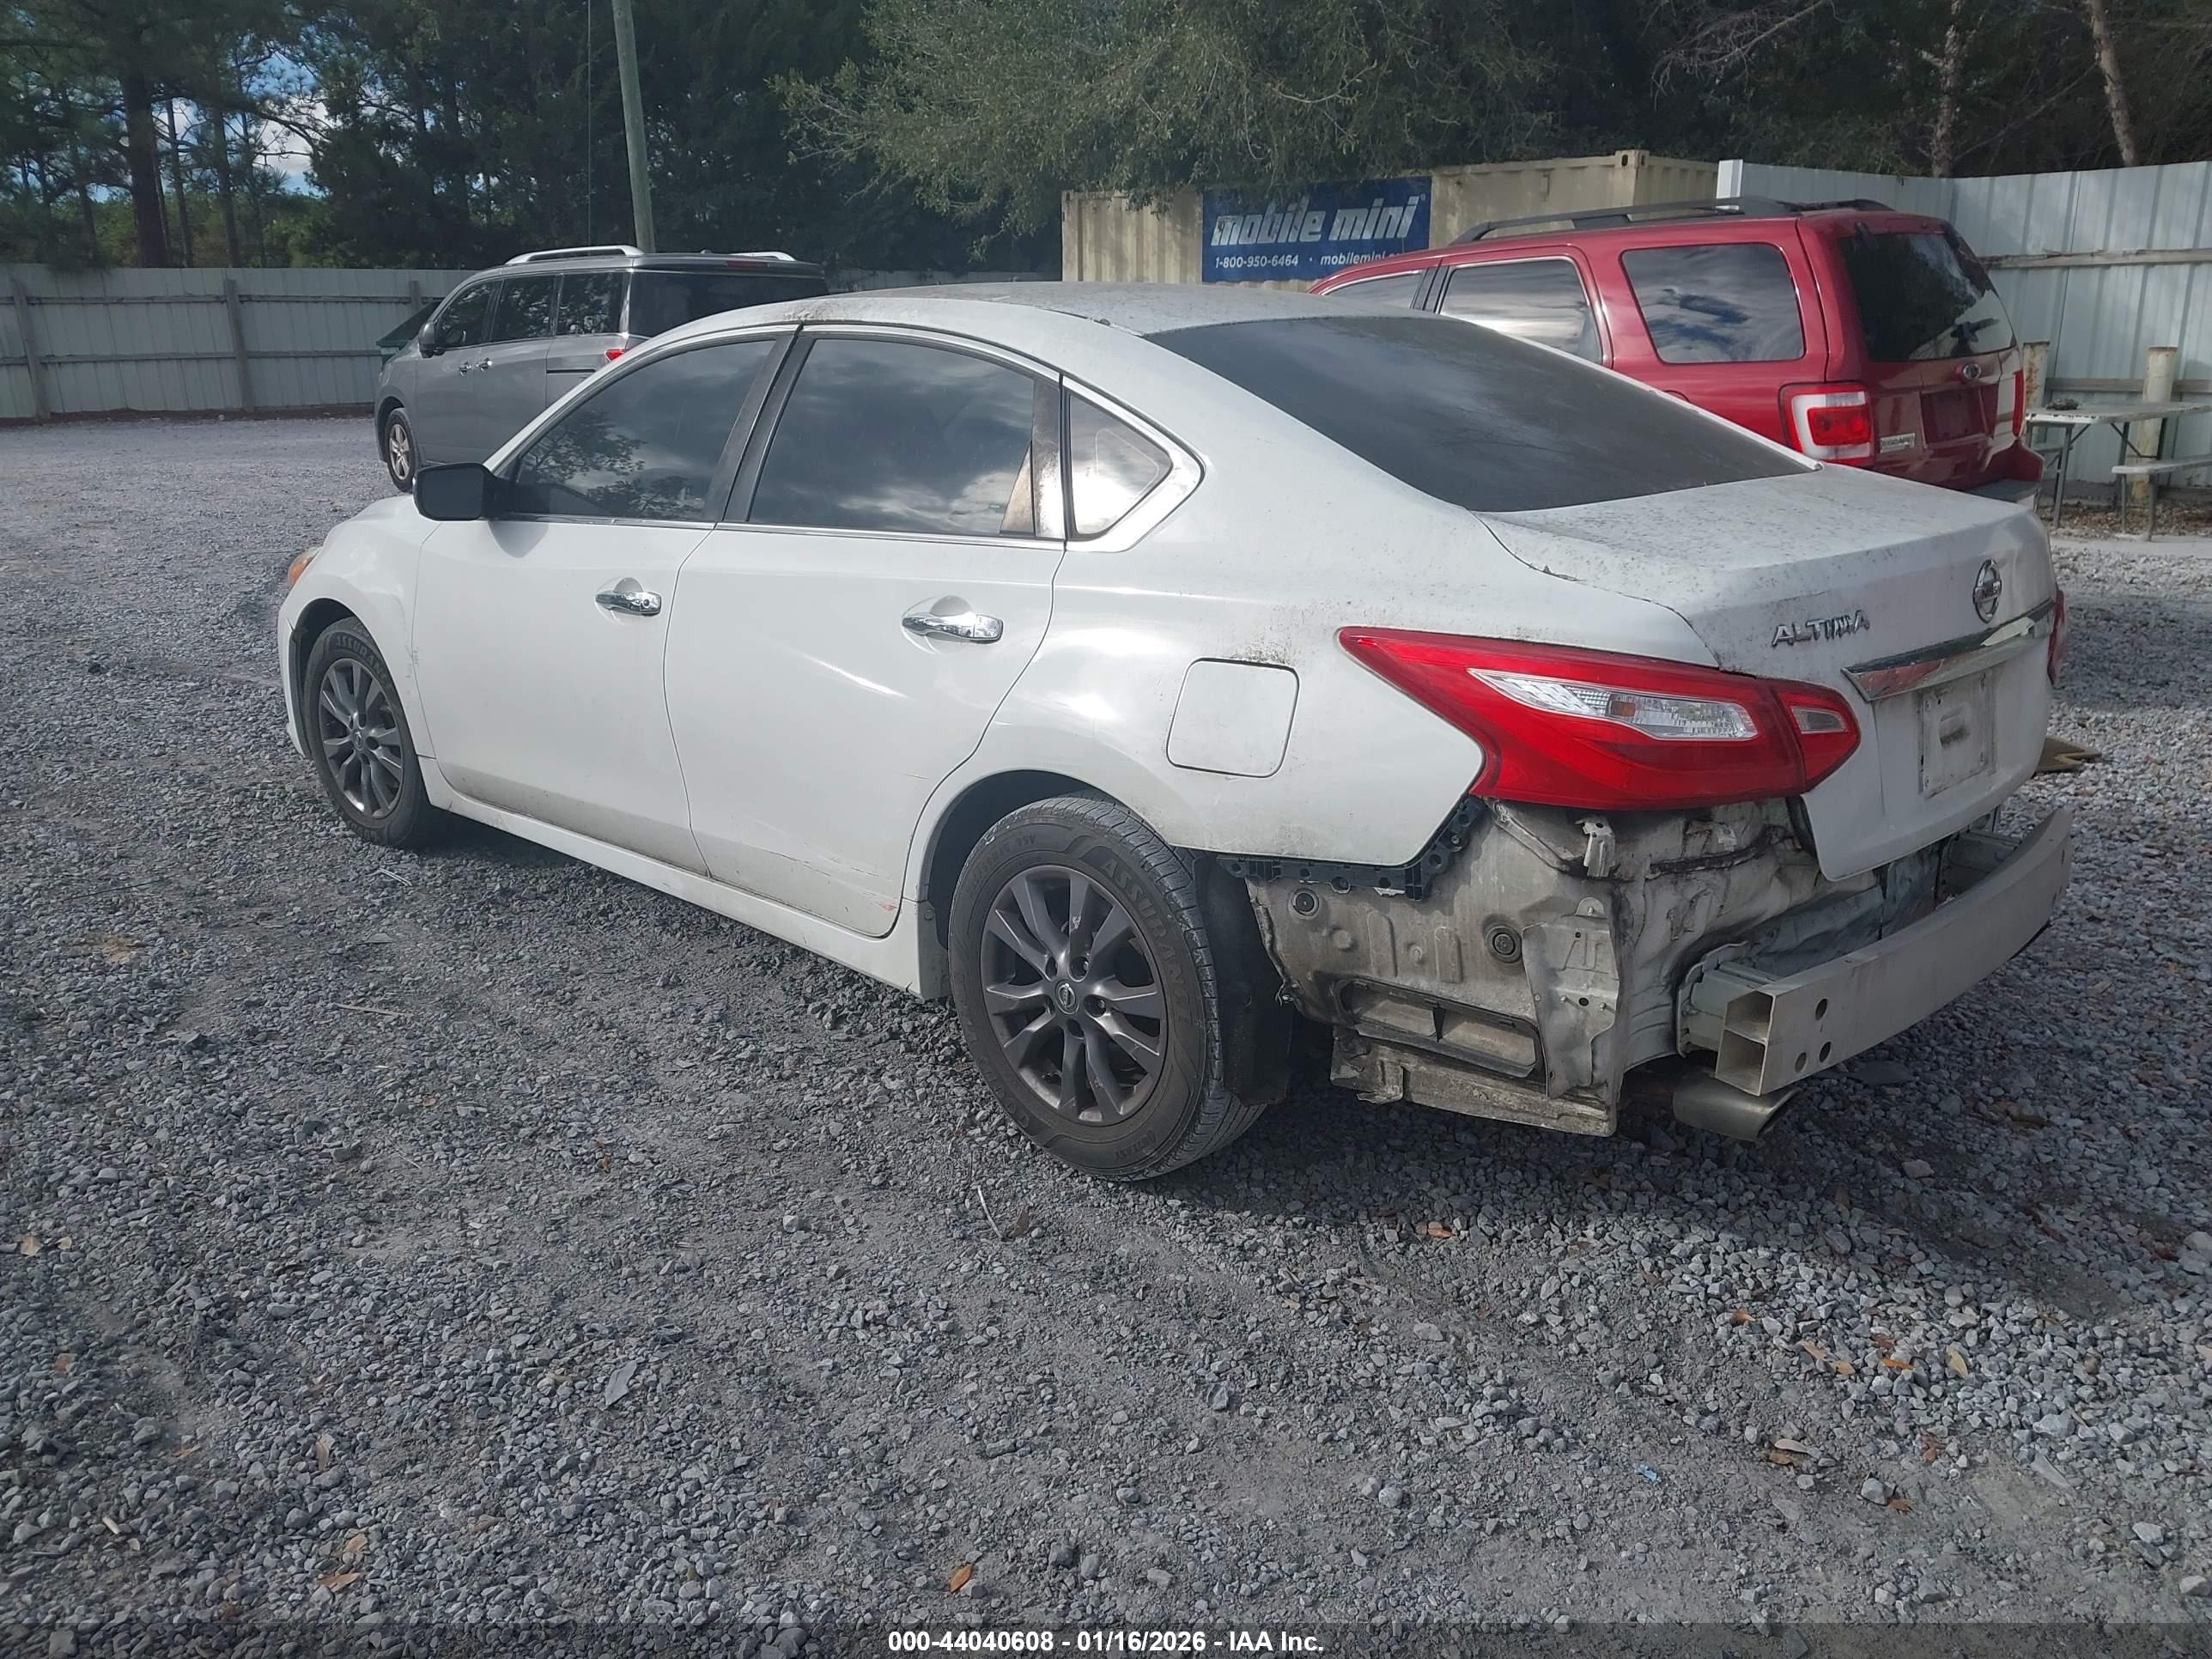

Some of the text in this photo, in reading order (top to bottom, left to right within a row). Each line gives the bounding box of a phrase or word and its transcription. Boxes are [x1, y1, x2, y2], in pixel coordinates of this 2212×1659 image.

[1211, 194, 1420, 246] mobile mini
[1214, 254, 1299, 268] 1-800-950-6464
[1771, 609, 1870, 647] ALTIMA
